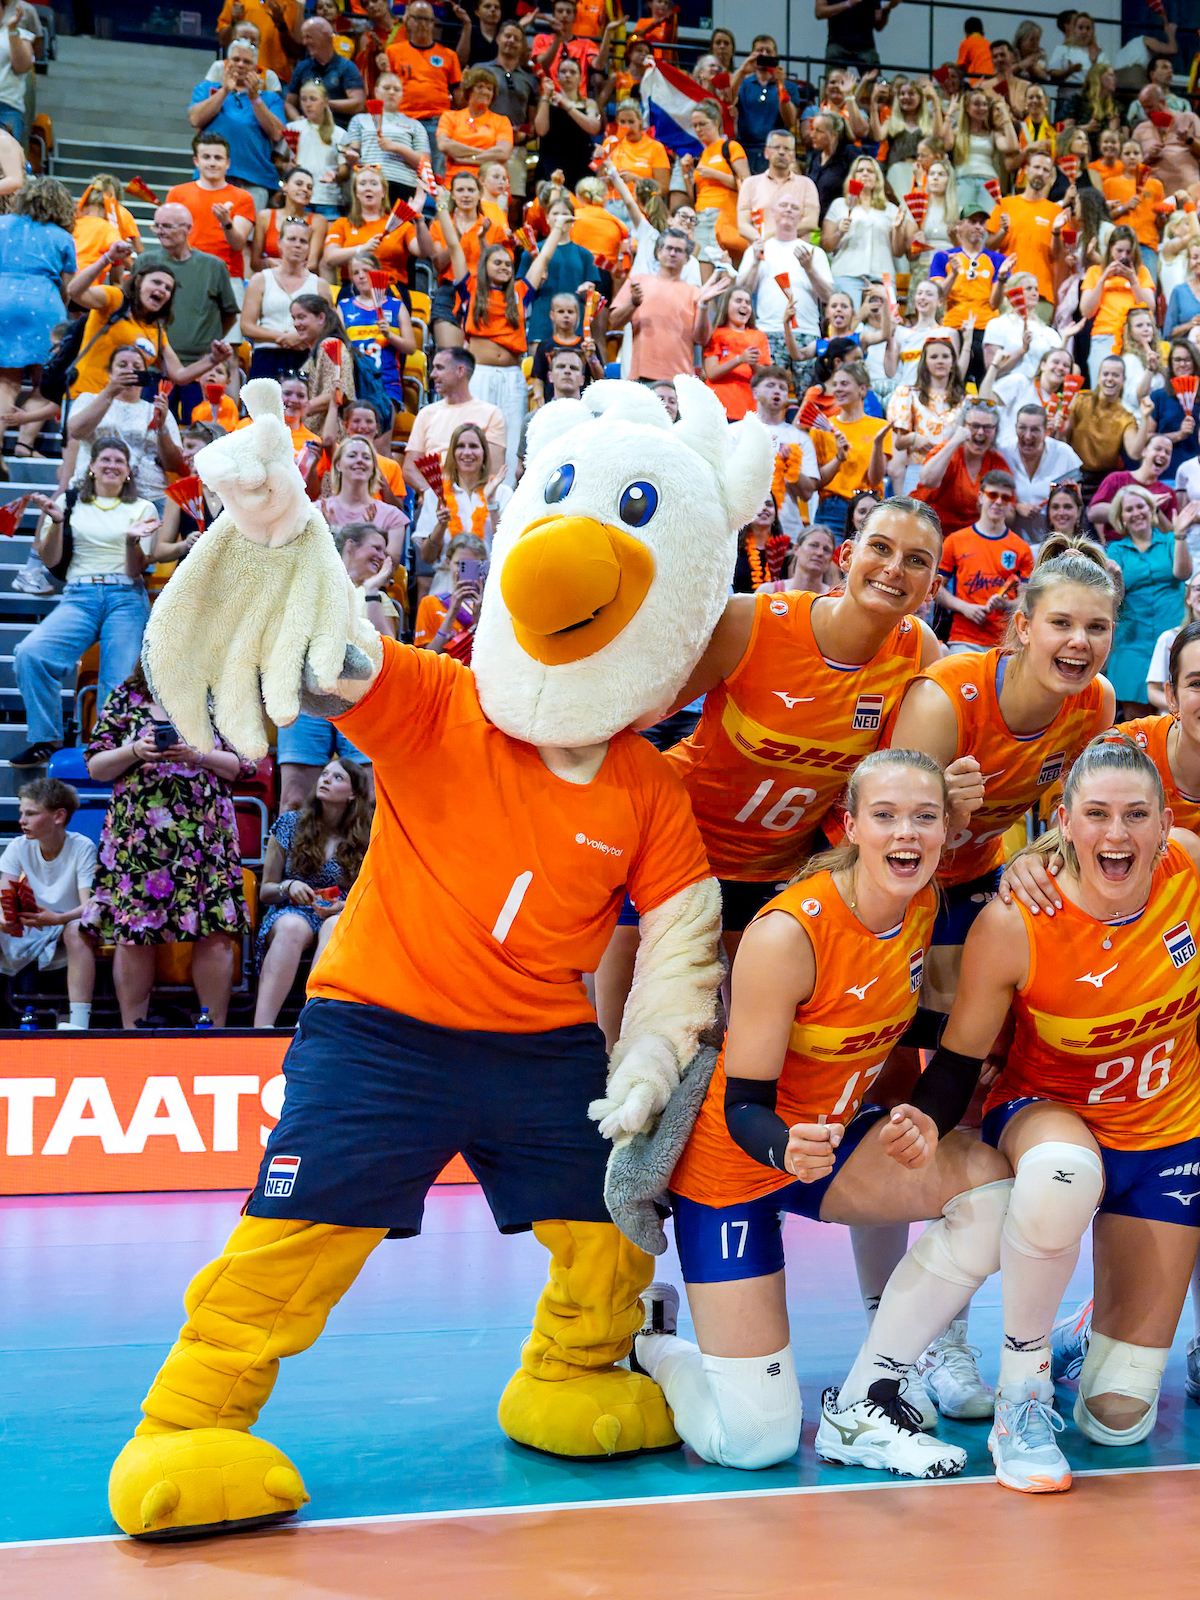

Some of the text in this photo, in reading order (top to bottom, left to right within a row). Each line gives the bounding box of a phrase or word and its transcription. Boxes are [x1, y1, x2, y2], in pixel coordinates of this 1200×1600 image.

[853, 715, 880, 729] NED
[1039, 768, 1061, 785] NED
[733, 778, 818, 832] 16
[586, 837, 623, 857] volleybal
[1172, 948, 1196, 967] NED
[910, 971, 924, 992] NED
[833, 1017, 916, 1056] DH
[1086, 1038, 1175, 1104] 26
[266, 1180, 293, 1196] NED
[720, 1220, 749, 1259] 17
